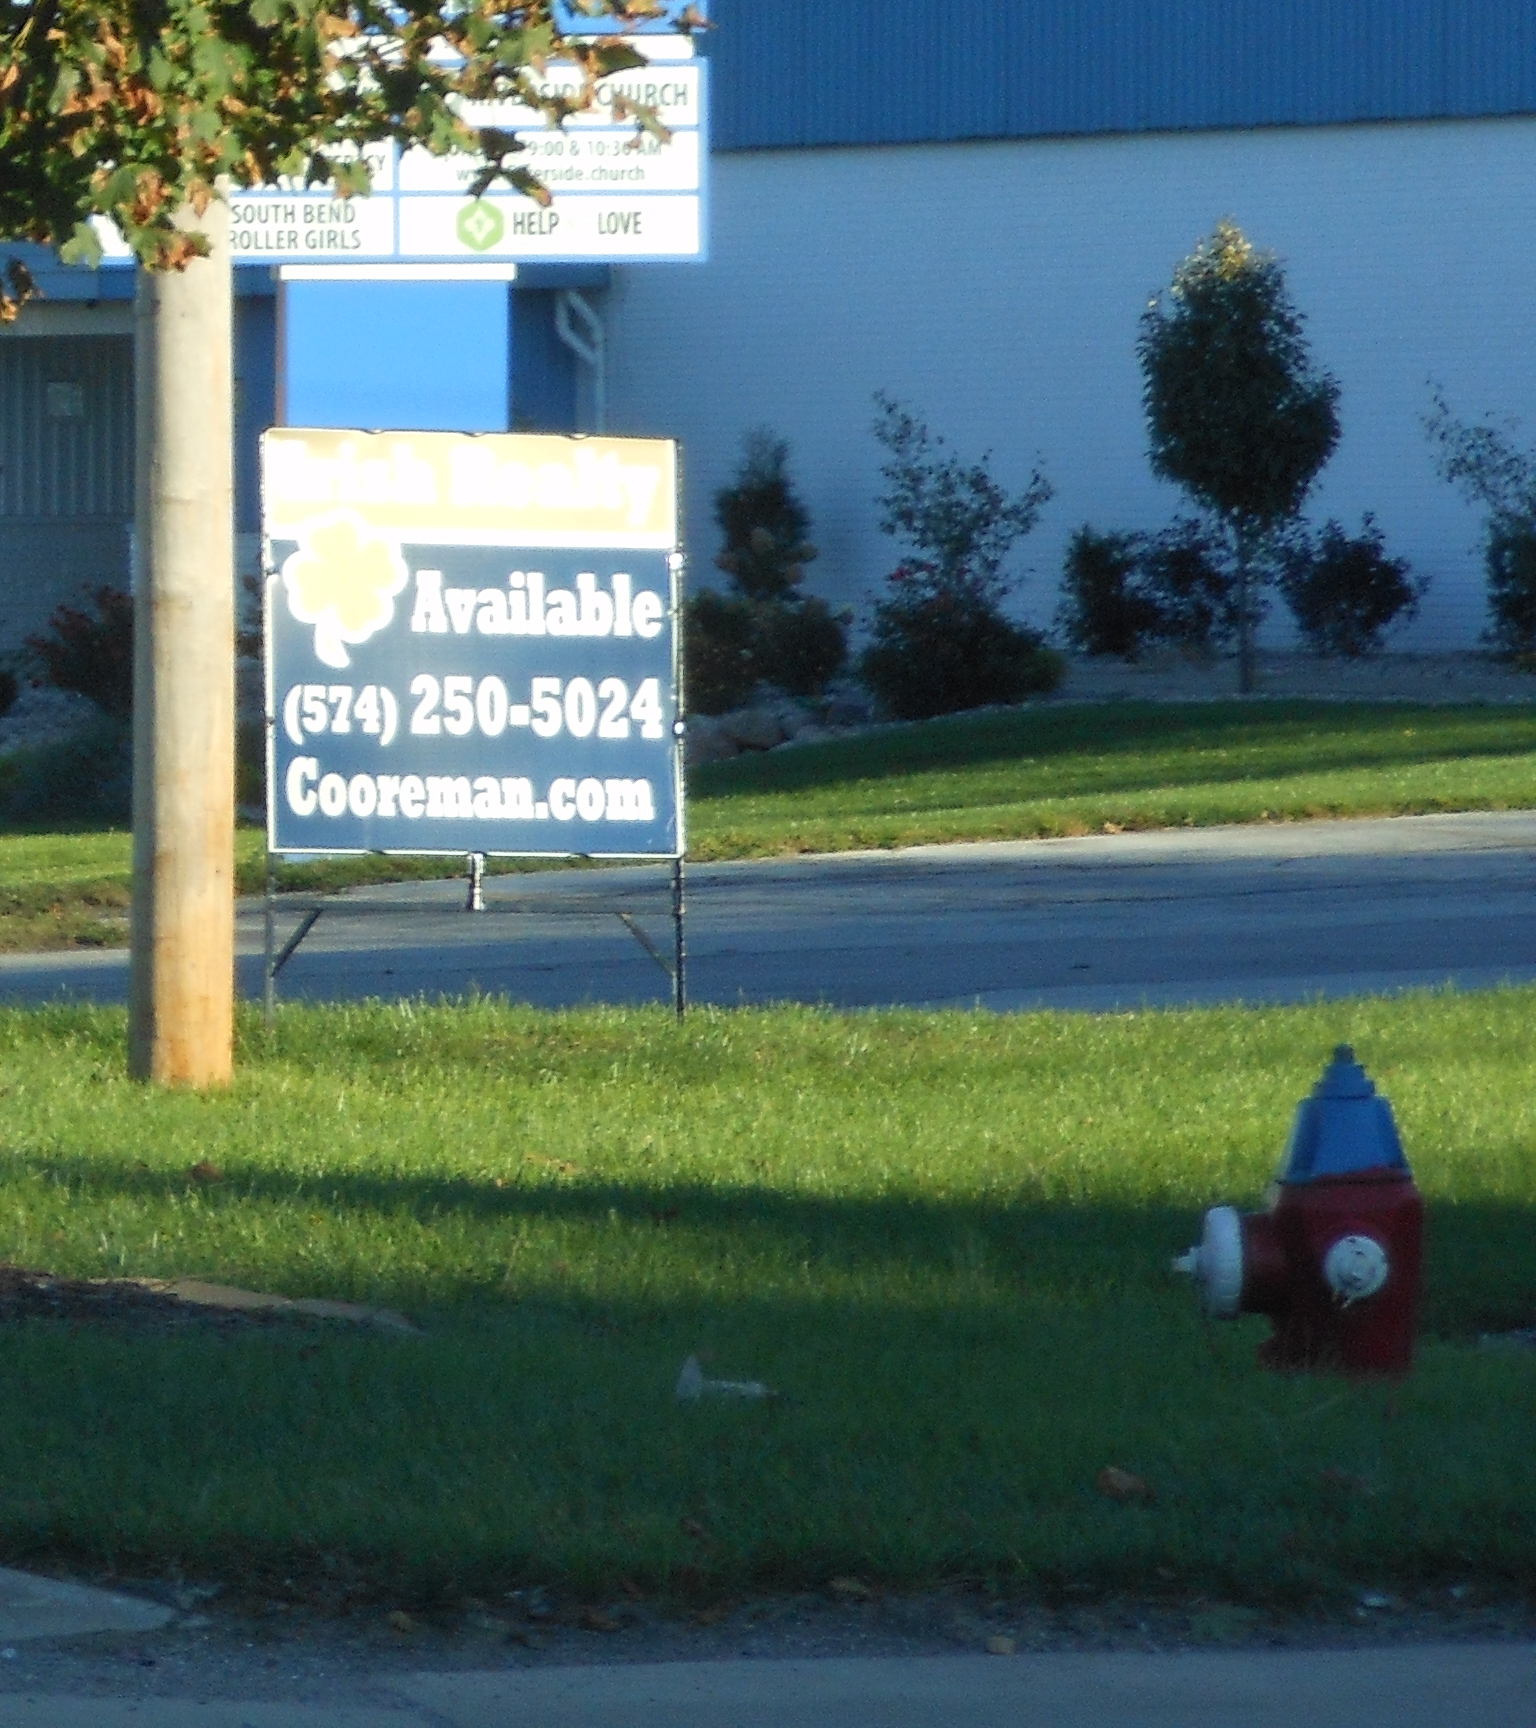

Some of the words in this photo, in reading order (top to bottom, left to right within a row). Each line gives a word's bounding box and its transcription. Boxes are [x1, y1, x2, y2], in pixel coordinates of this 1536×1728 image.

[596, 83, 688, 106] CHURCH
[231, 204, 296, 224] SOUTH
[303, 204, 356, 224] BEND
[512, 212, 560, 235] HELP
[597, 212, 643, 235] LOVE
[229, 229, 299, 250] ROLLER
[305, 229, 362, 250] GIRLS
[411, 570, 663, 639] Available
[283, 683, 399, 747] (574)
[410, 674, 663, 739] 250-5024
[285, 755, 655, 822] Cooreman.com
